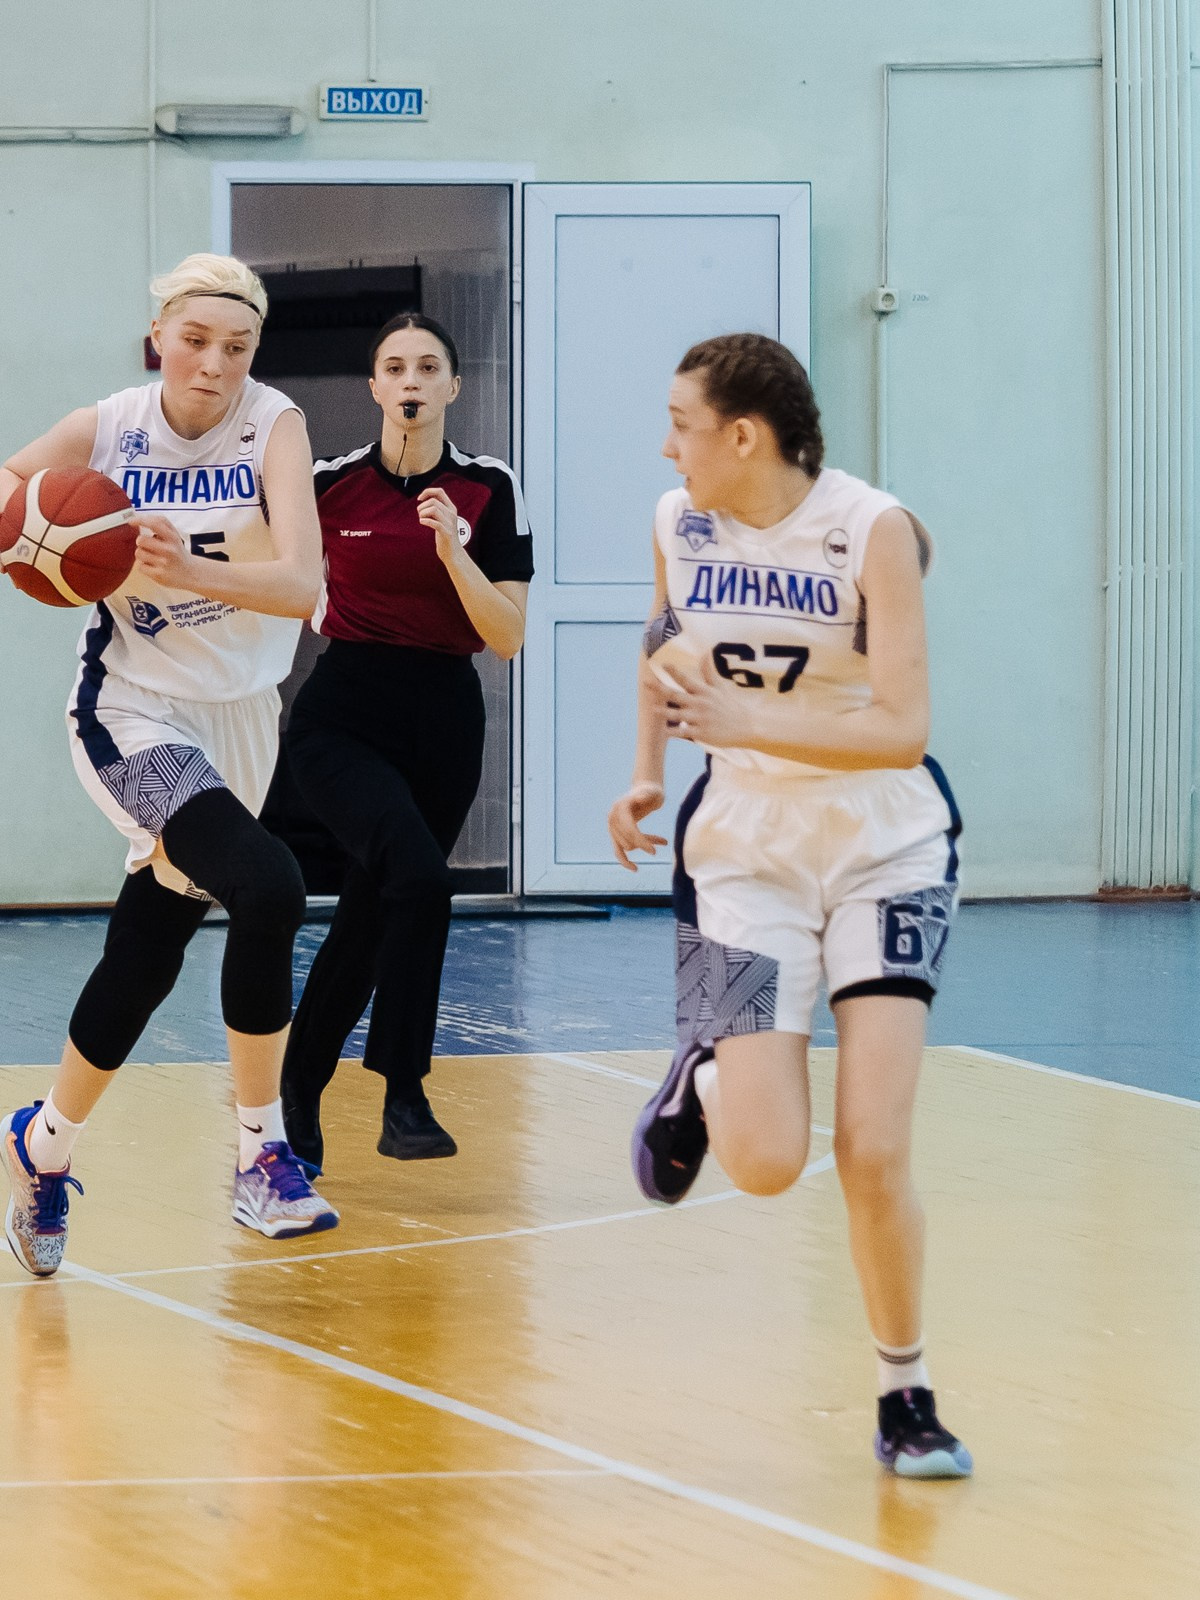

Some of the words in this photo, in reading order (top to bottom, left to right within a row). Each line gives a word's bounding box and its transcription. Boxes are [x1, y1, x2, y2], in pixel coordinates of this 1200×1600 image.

[332, 91, 418, 115] ВЫХОД
[121, 463, 256, 509] ДИНАМО
[166, 597, 213, 613] ПЕРВИЧНА
[686, 565, 838, 616] ДИНАМО
[712, 641, 810, 694] 67
